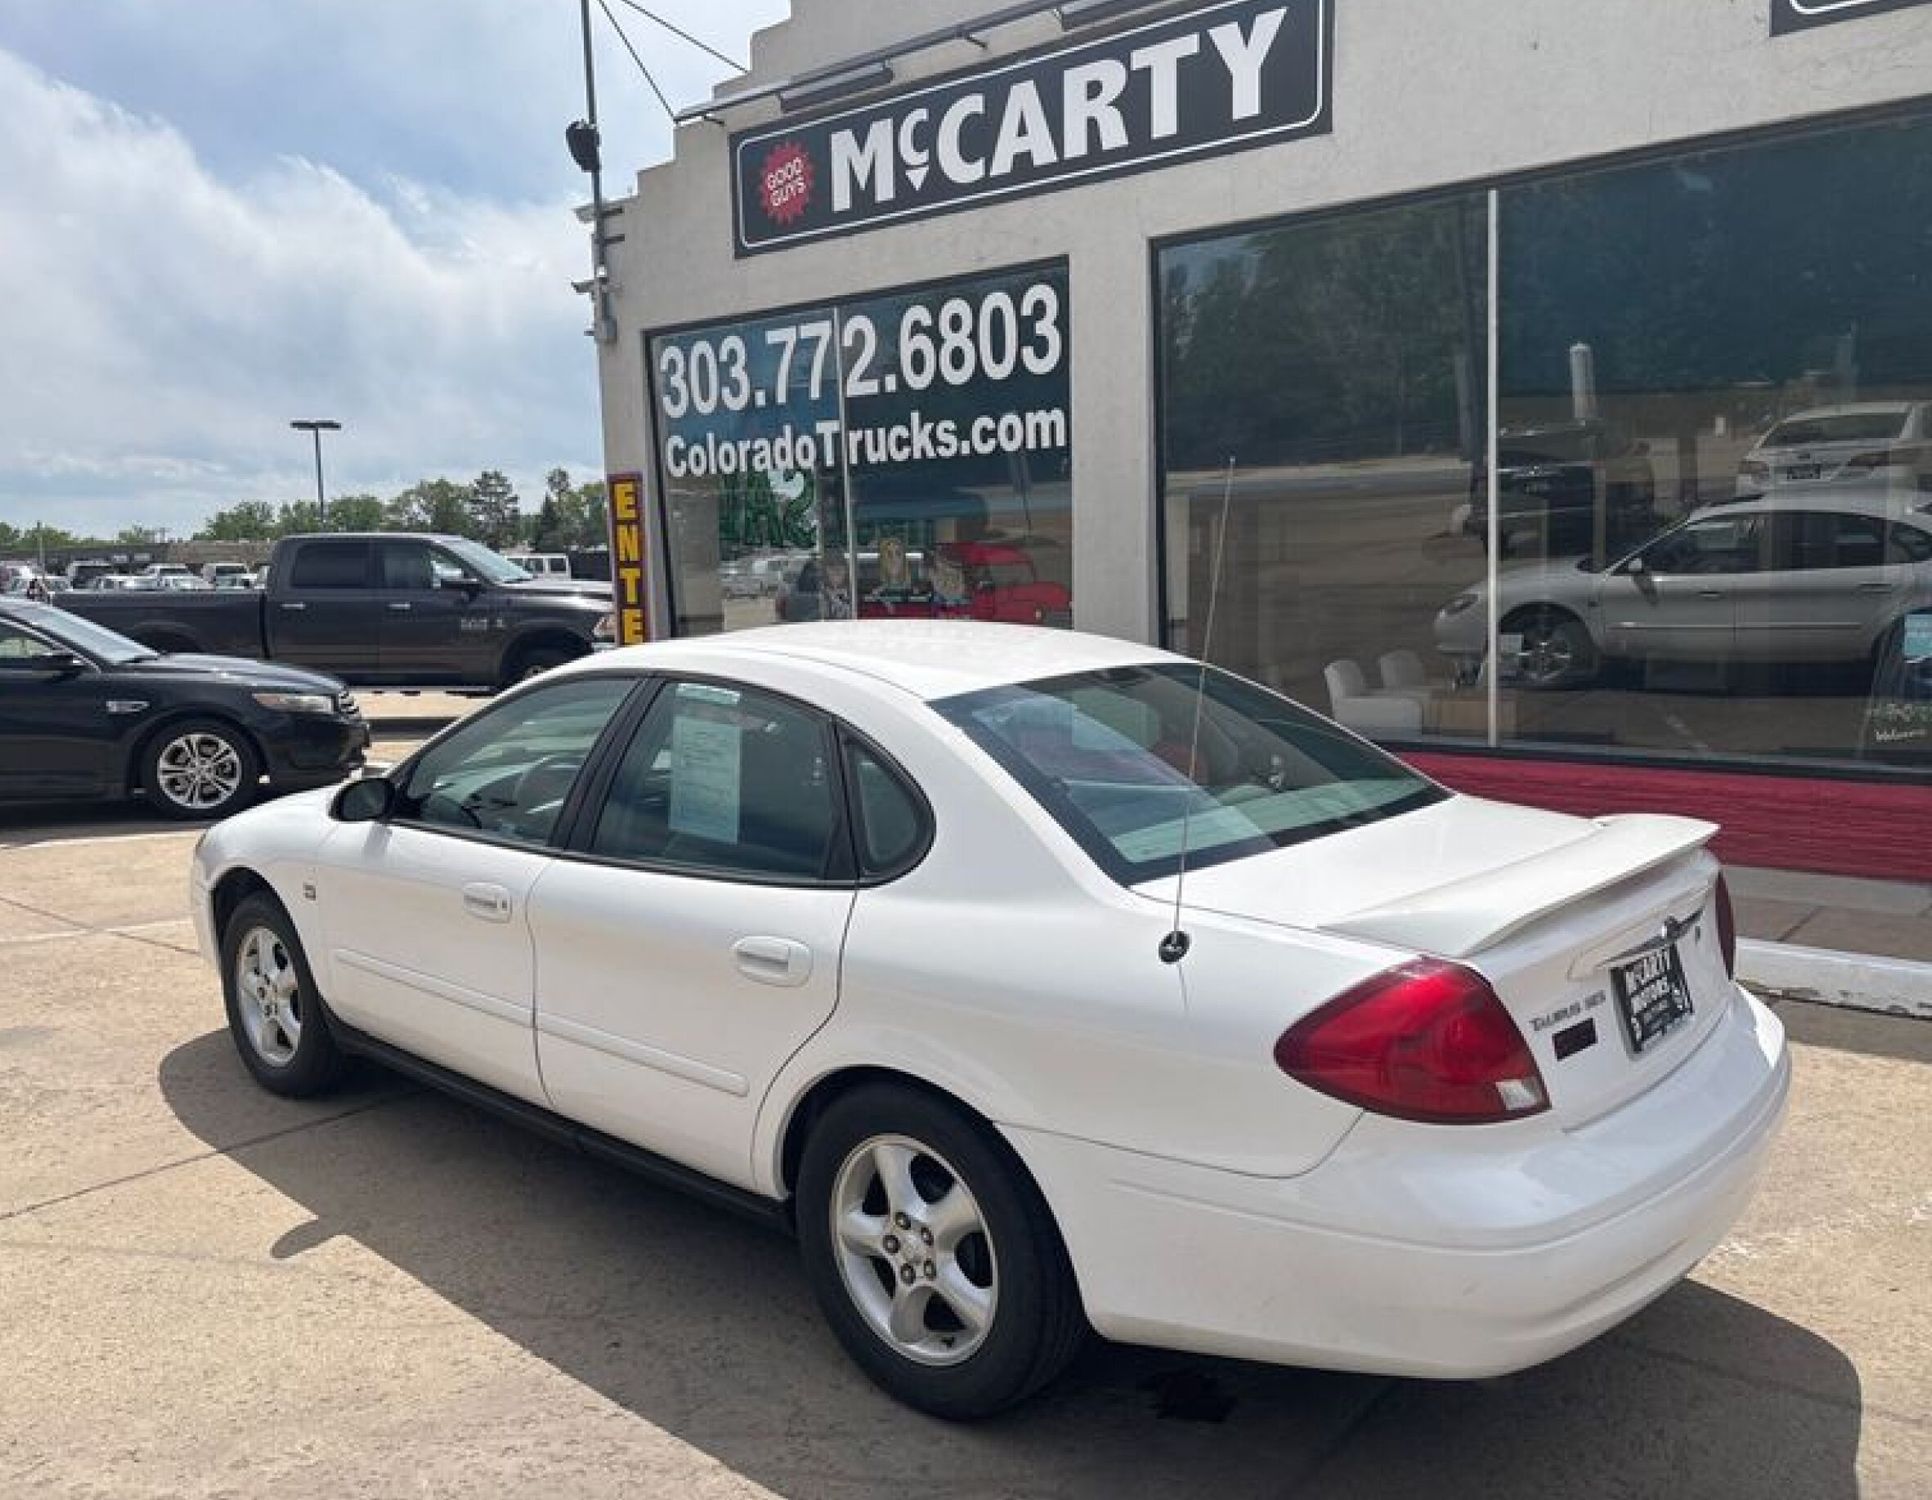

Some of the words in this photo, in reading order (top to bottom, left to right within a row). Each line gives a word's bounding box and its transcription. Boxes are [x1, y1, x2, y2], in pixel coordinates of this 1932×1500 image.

[766, 156, 804, 190] GOOD
[769, 176, 807, 207] GUYS
[659, 284, 1063, 419] 303.772.6803
[665, 406, 1066, 479] ColoradoTrucks.com
